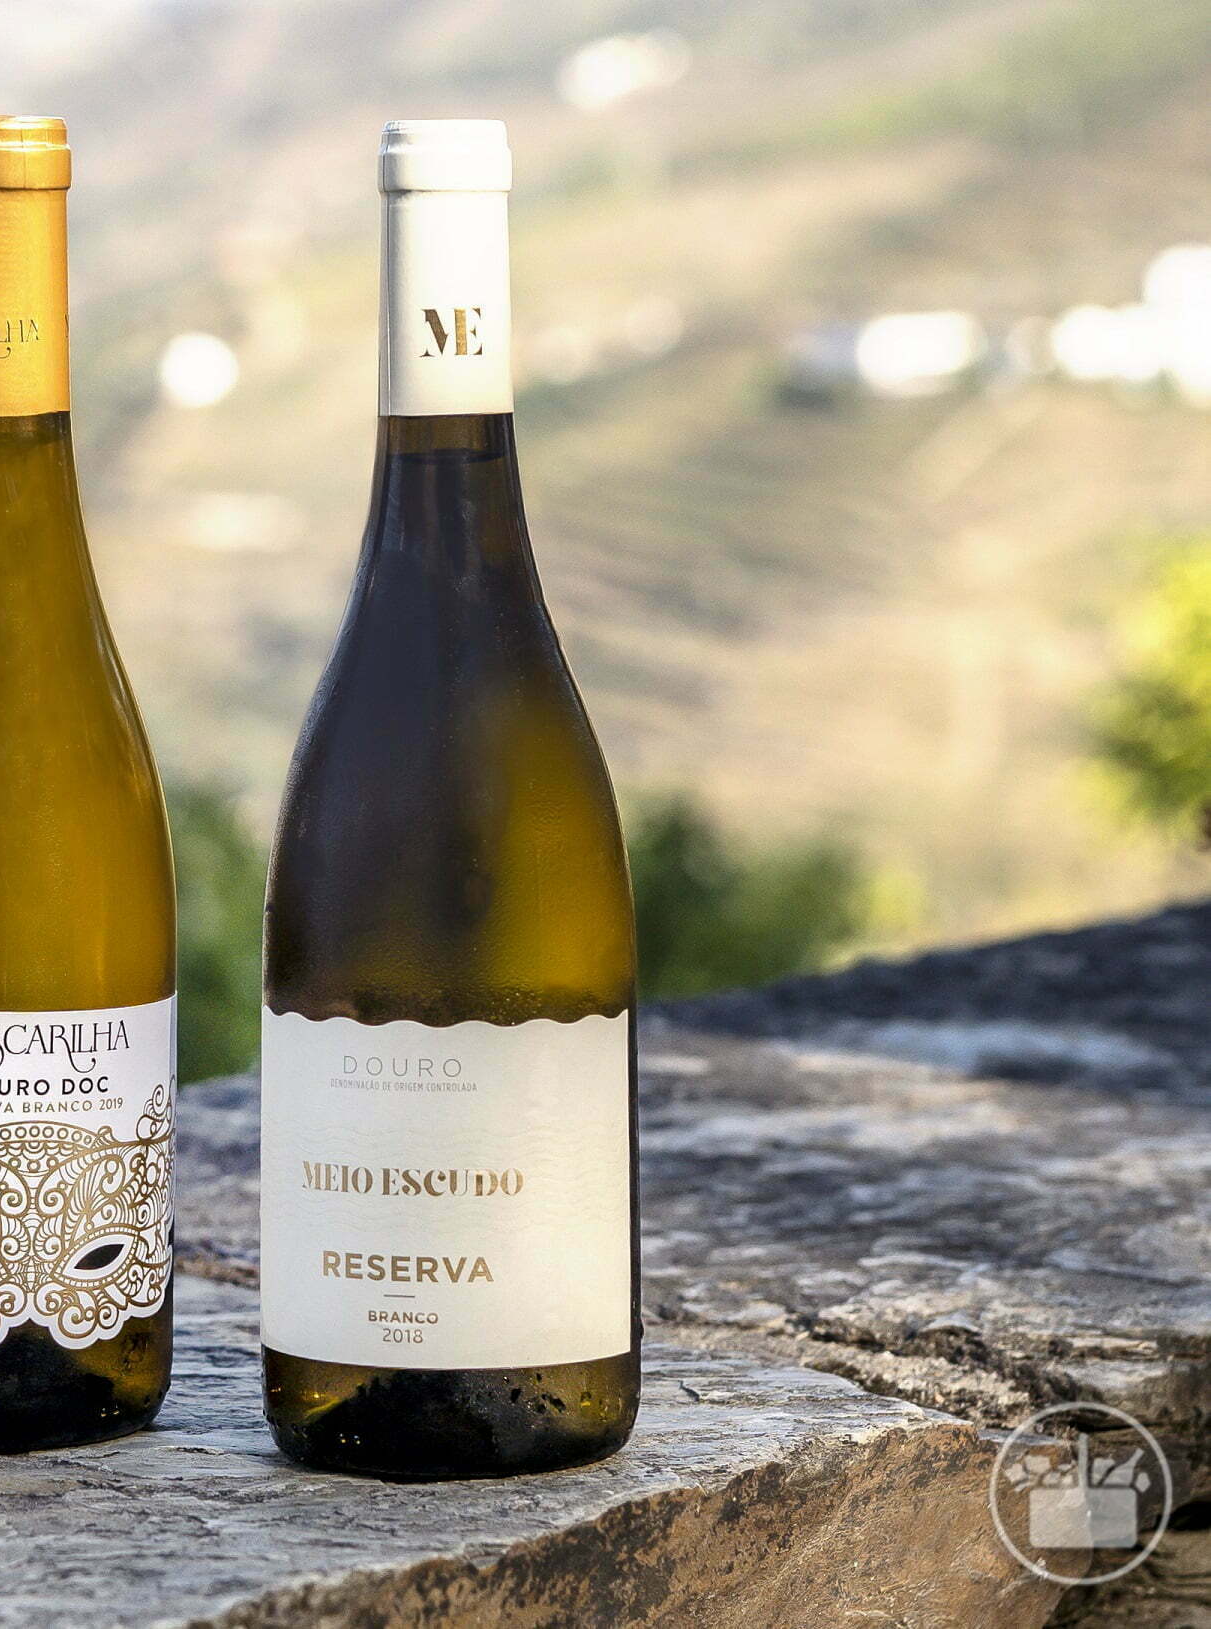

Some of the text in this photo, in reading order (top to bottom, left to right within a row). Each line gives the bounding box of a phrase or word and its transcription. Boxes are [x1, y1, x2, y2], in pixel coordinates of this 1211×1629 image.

[419, 307, 483, 358] ME
[343, 1055, 462, 1078] DOURO
[61, 1076, 110, 1096] DOC
[330, 1078, 478, 1093] DENOMINAÇÃO DE ORIGEM CONTROLADA
[22, 1100, 93, 1114] BRANCO
[99, 1097, 124, 1112] 2019
[301, 1160, 526, 1198] MEIO ESCUDO
[322, 1250, 494, 1283] RESERVA
[367, 1310, 439, 1325] BRANCO
[382, 1328, 424, 1344] 2018
